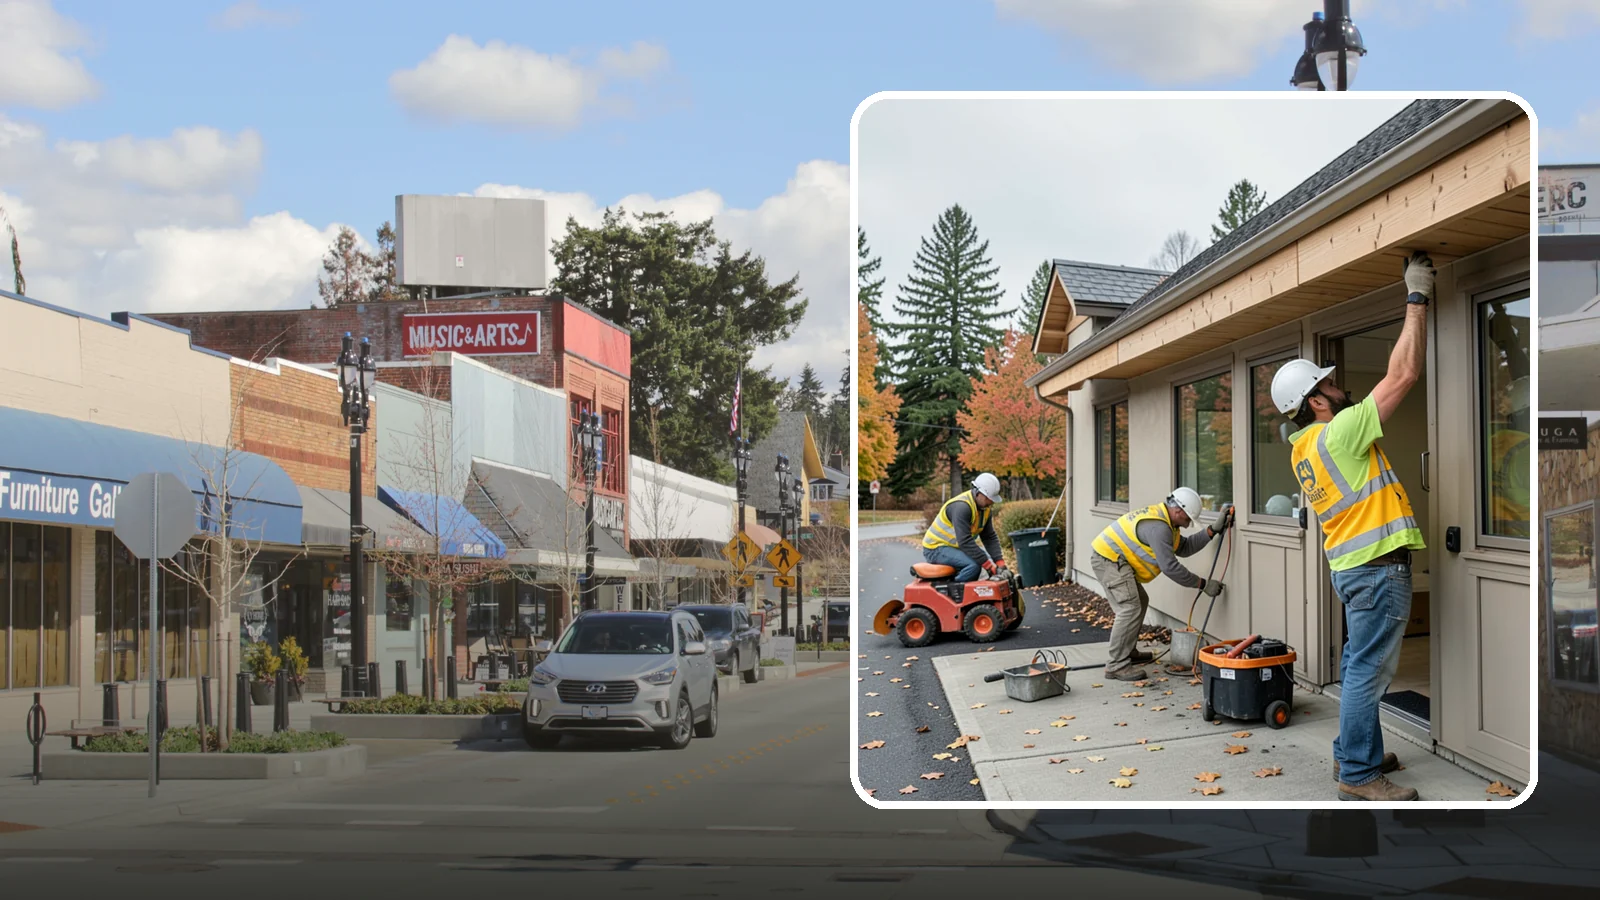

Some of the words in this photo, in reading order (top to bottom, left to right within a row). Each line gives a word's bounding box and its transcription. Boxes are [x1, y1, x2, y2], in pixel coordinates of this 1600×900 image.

[0, 472, 79, 515] Furniture
[90, 482, 121, 519] Gal
[453, 563, 479, 574] SUSHI
